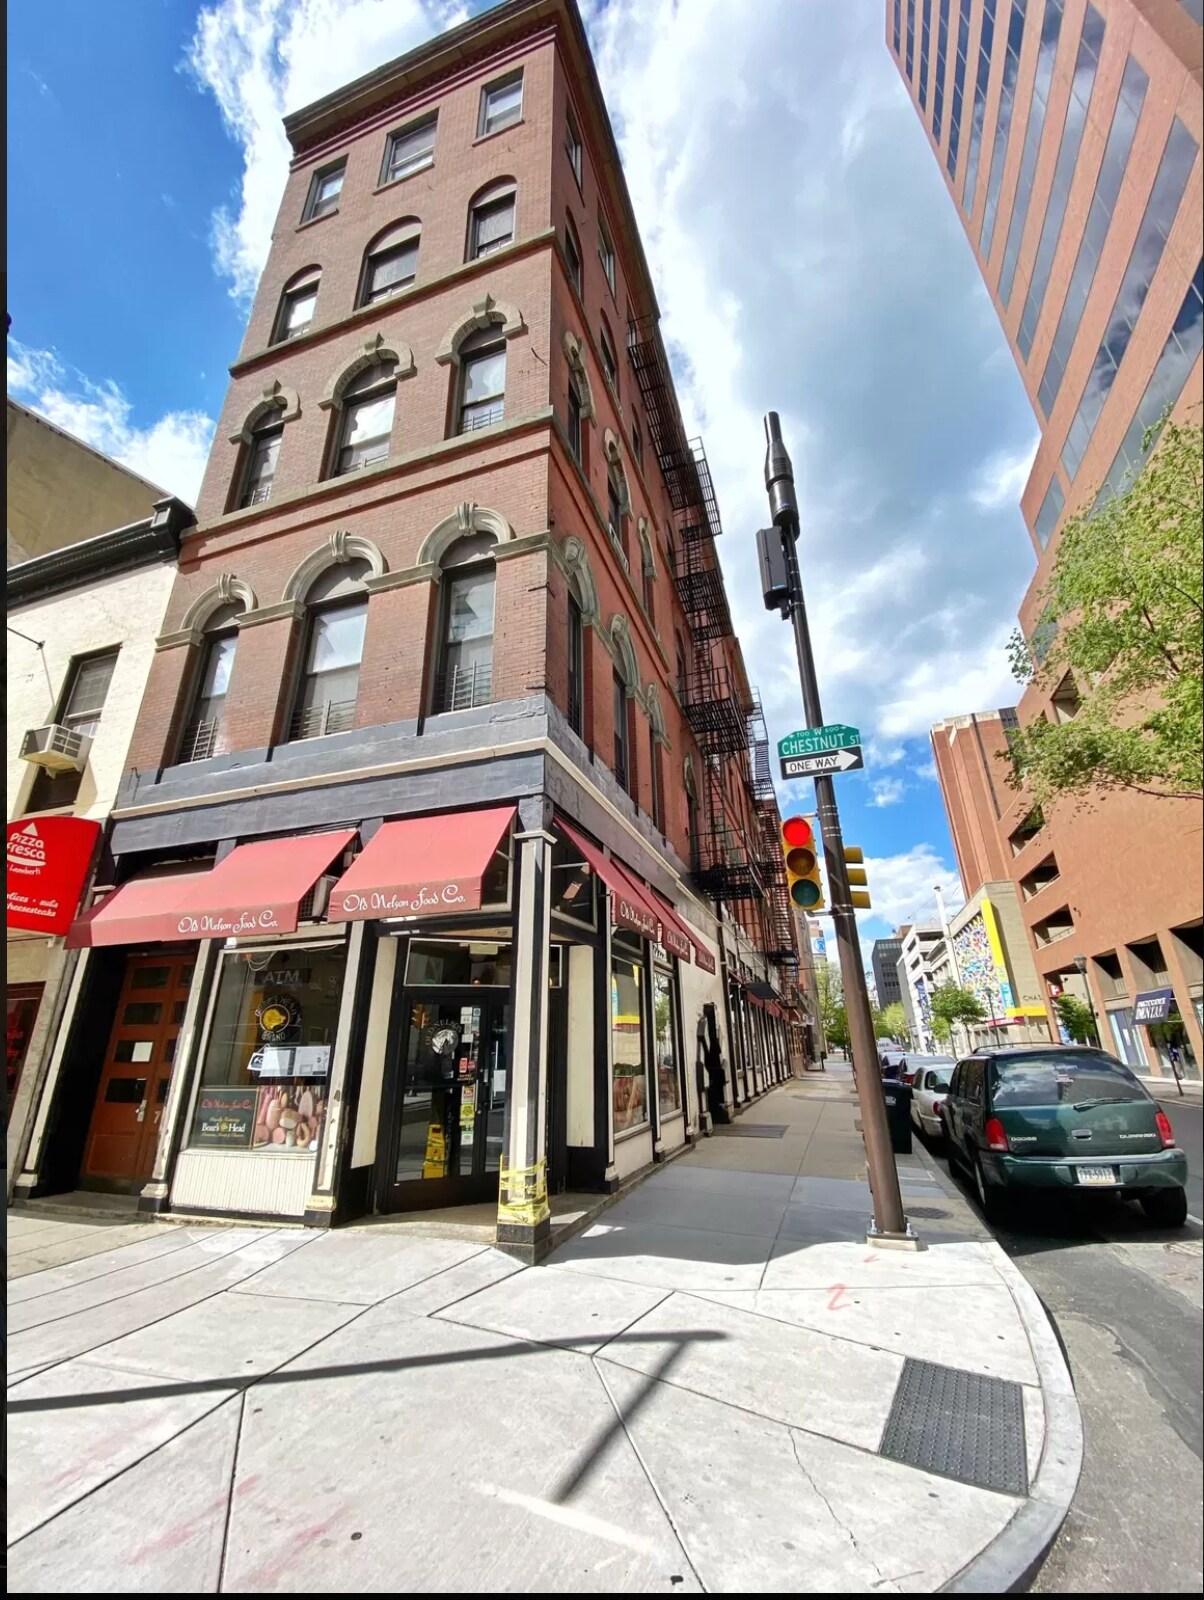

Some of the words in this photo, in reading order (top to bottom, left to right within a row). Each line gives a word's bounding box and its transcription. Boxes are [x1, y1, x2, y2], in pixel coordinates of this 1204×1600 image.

[813, 727, 823, 736] W
[781, 734, 845, 755] CHESTNUT
[849, 734, 860, 745] ST
[789, 760, 811, 772] ONE
[815, 756, 838, 768] WAY
[10, 832, 44, 848] Pizza
[343, 894, 368, 912] Old
[370, 893, 409, 909] Nelson
[410, 887, 439, 911] Food
[441, 884, 466, 904] Co.
[177, 916, 199, 933] Old
[201, 917, 232, 931] Nelson
[232, 911, 256, 932] Food
[258, 909, 278, 928] Co.
[263, 970, 300, 984] ATM
[228, 1123, 246, 1133] Head
[826, 1283, 850, 1311] 2
